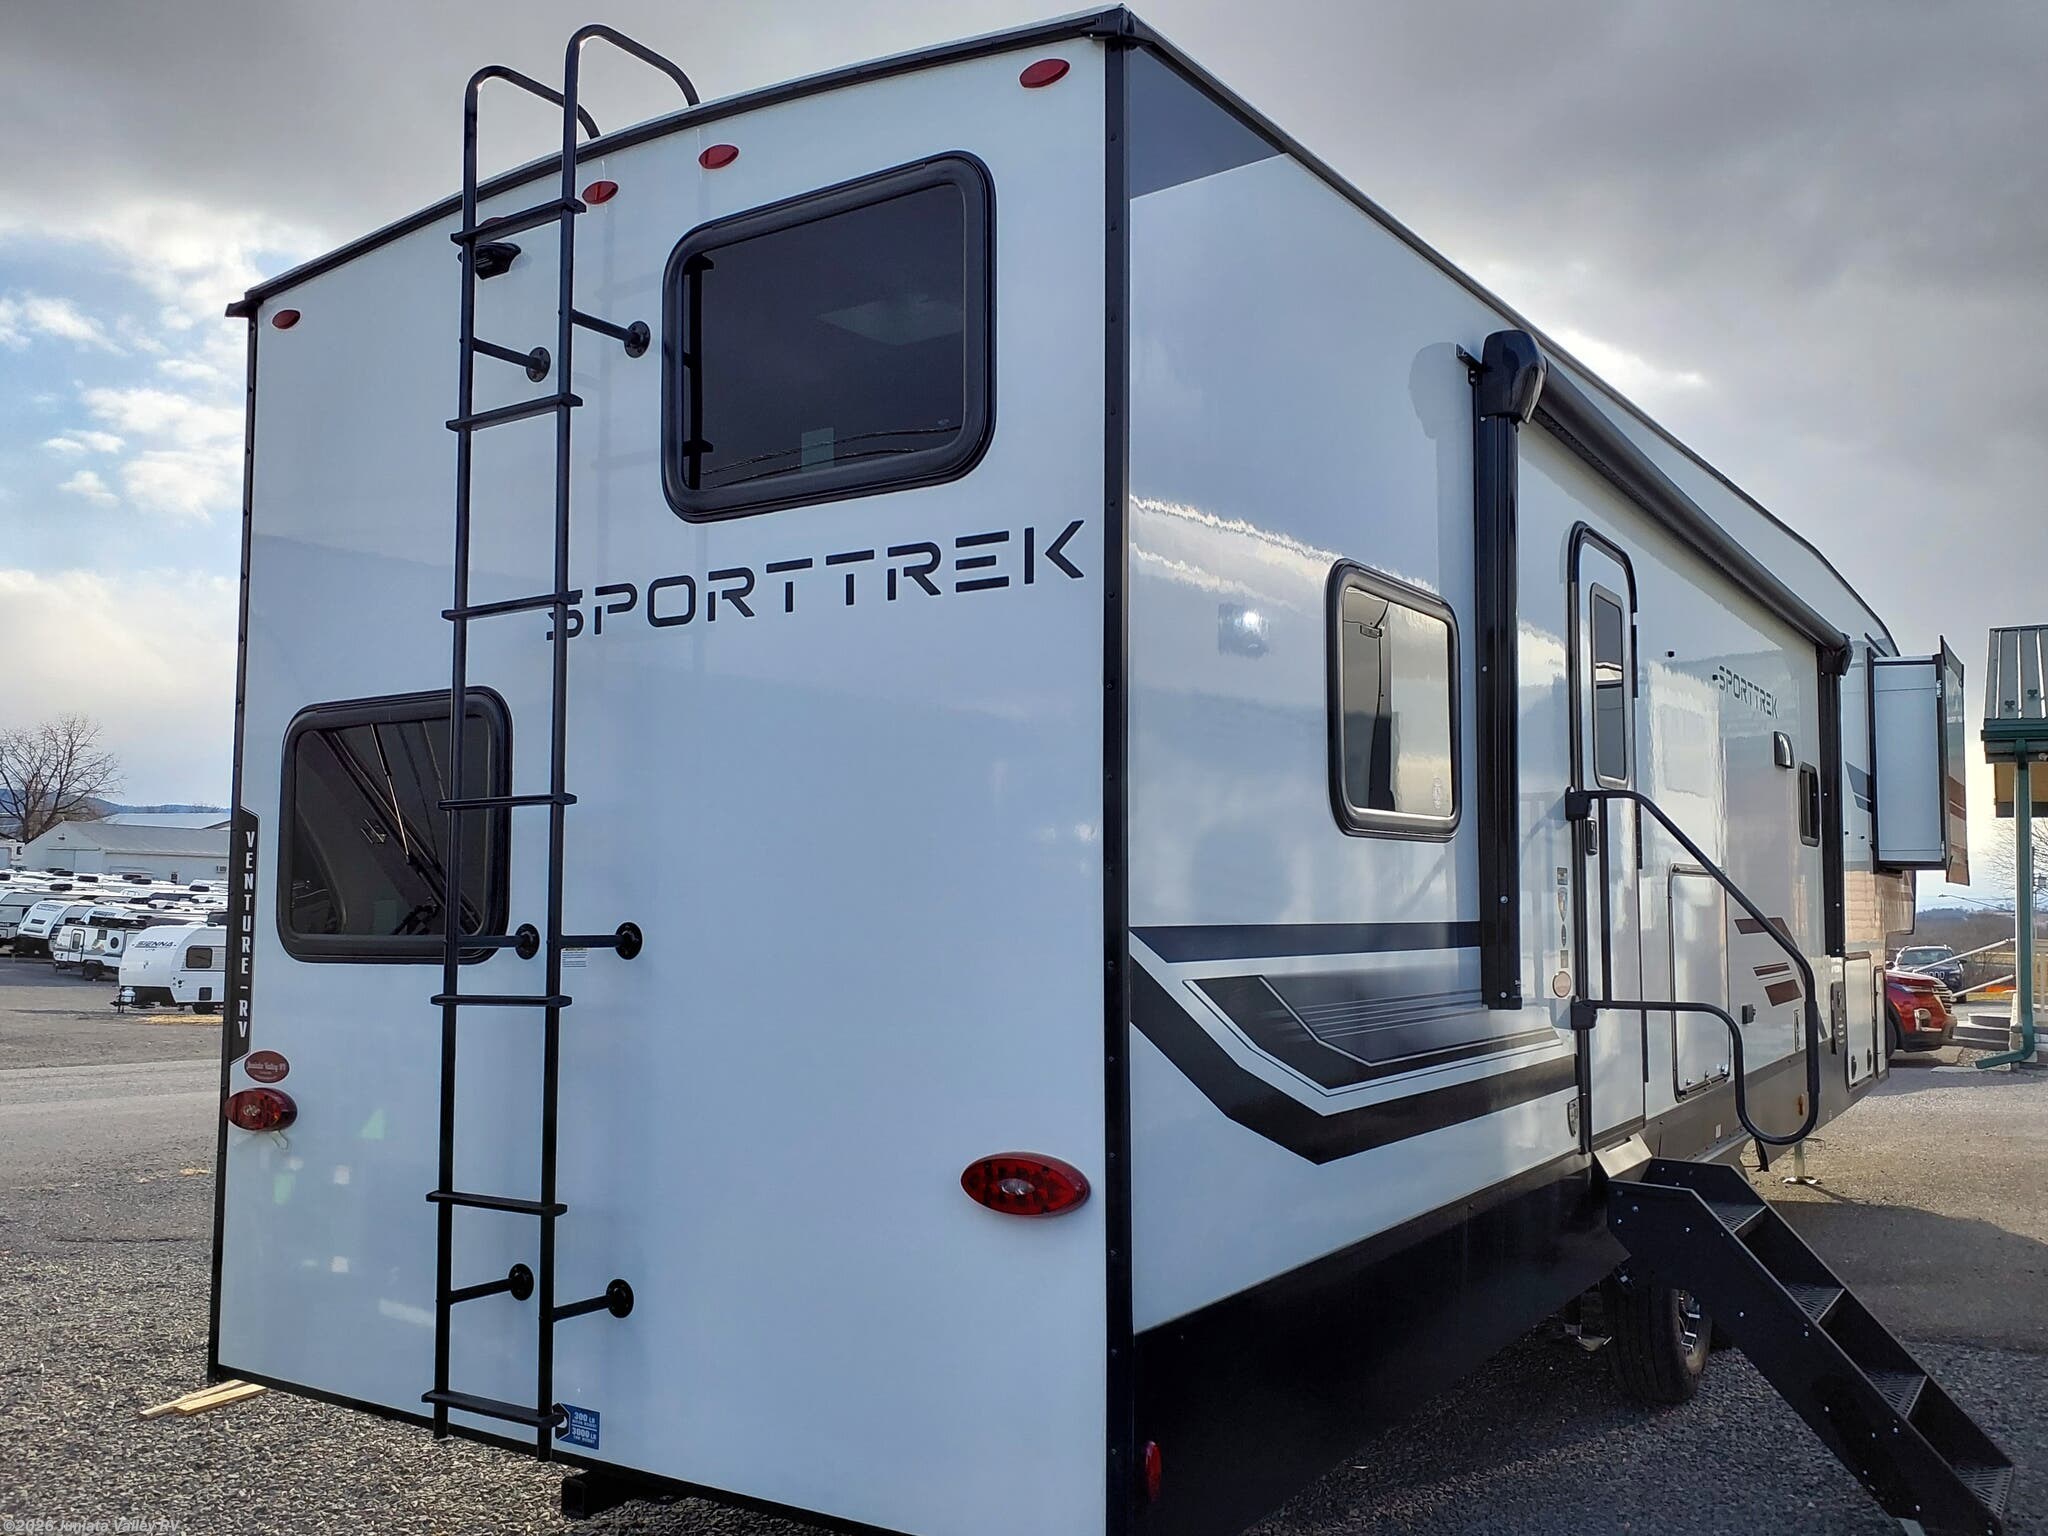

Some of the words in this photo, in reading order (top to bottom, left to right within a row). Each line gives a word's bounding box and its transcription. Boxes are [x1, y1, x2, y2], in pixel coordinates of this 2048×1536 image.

[546, 520, 1086, 641] SPORTTREK
[1719, 665, 1778, 720] SPORTTREK
[136, 940, 174, 949] SIENNA
[574, 1412, 588, 1422] 300
[572, 1427, 590, 1438] 3000
